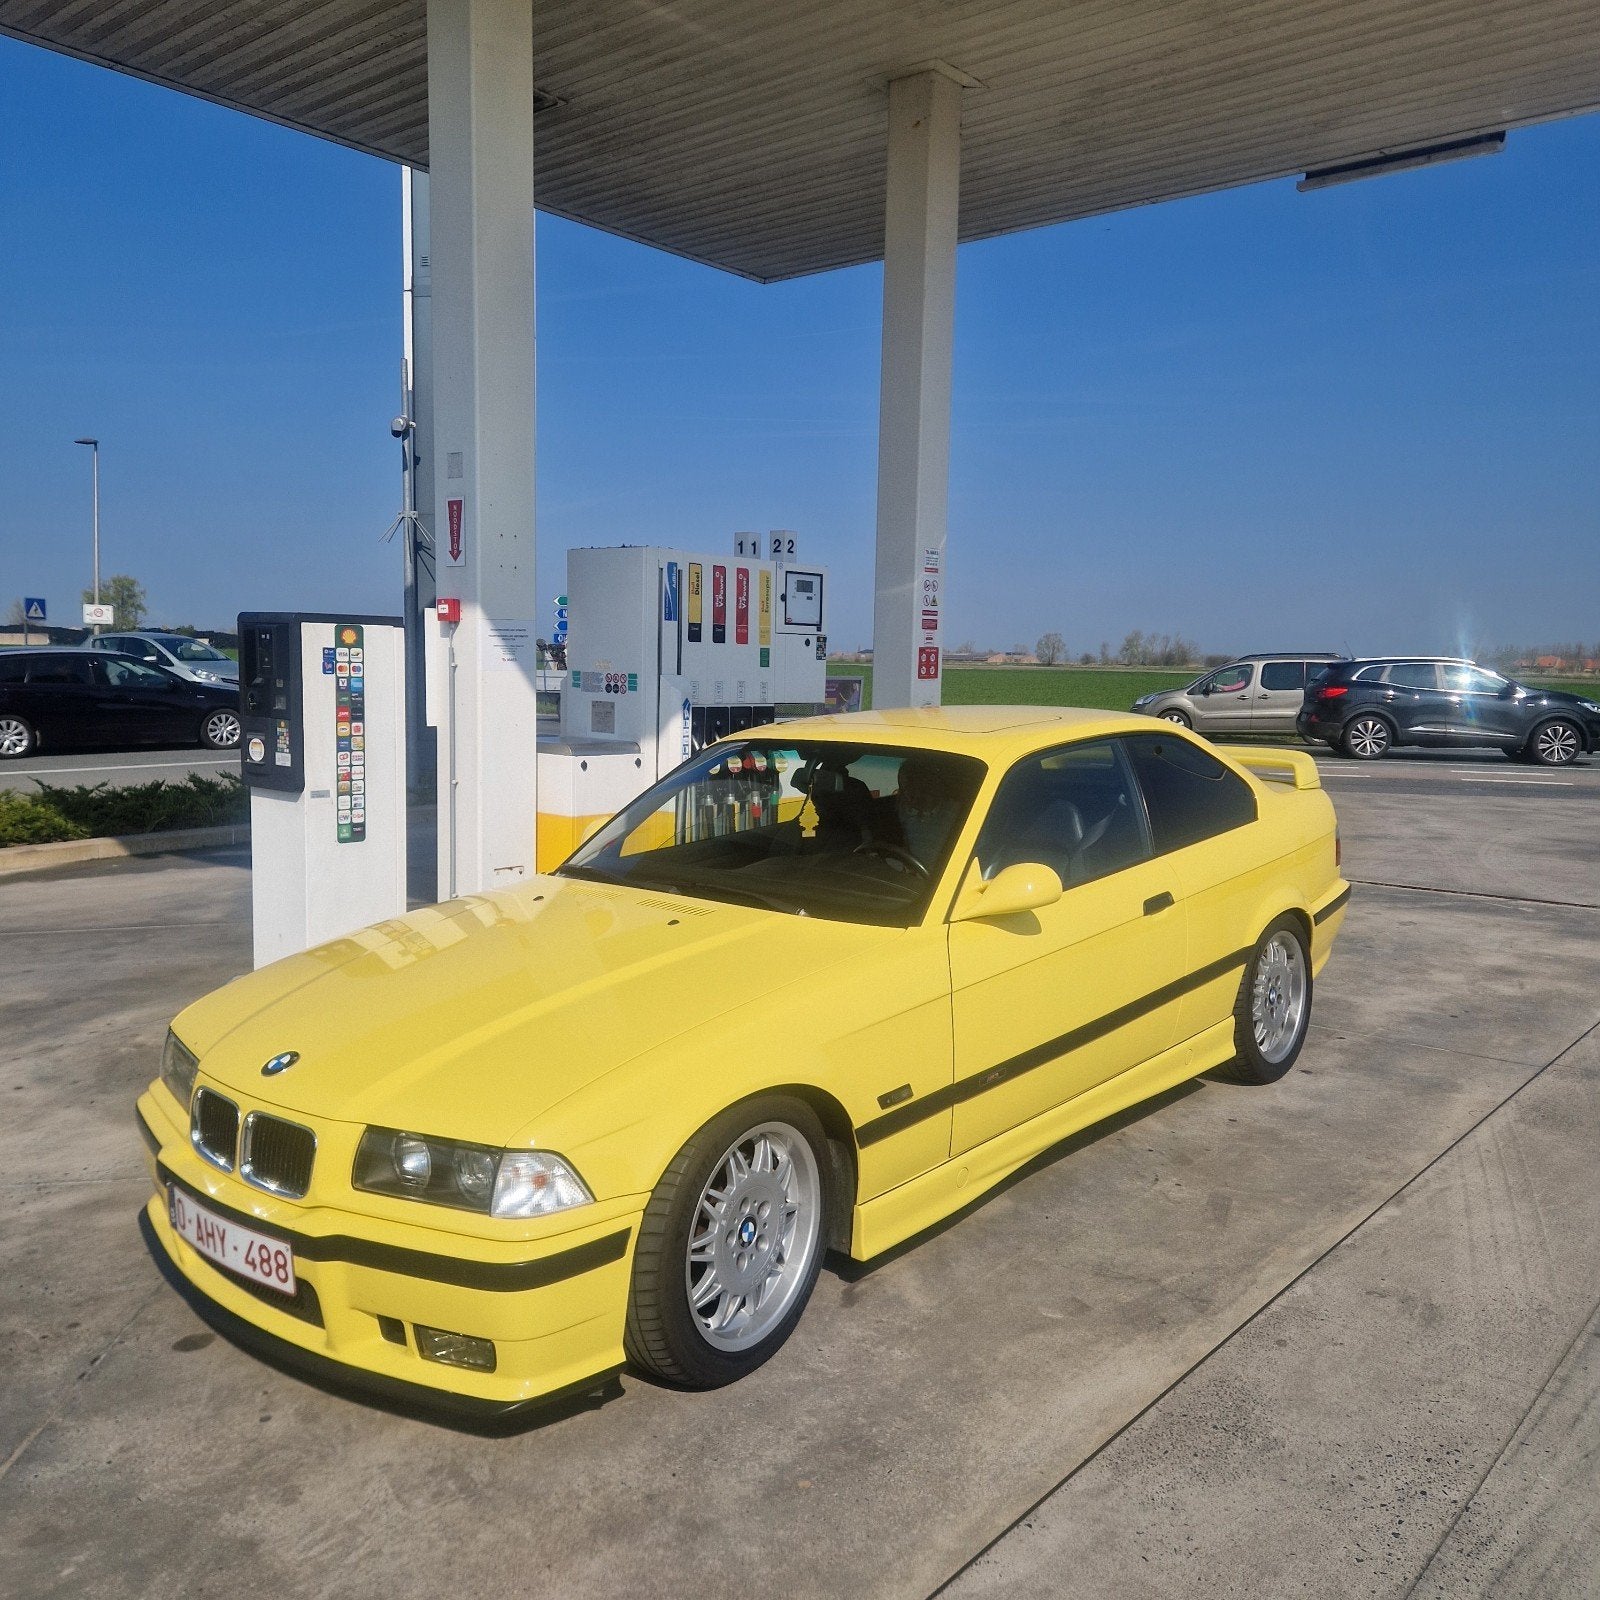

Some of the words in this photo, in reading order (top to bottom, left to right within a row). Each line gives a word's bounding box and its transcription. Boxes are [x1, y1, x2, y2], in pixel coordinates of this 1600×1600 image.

[737, 540, 744, 554] 1
[751, 541, 757, 555] 1
[773, 538, 781, 553] 2
[787, 539, 795, 553] 2
